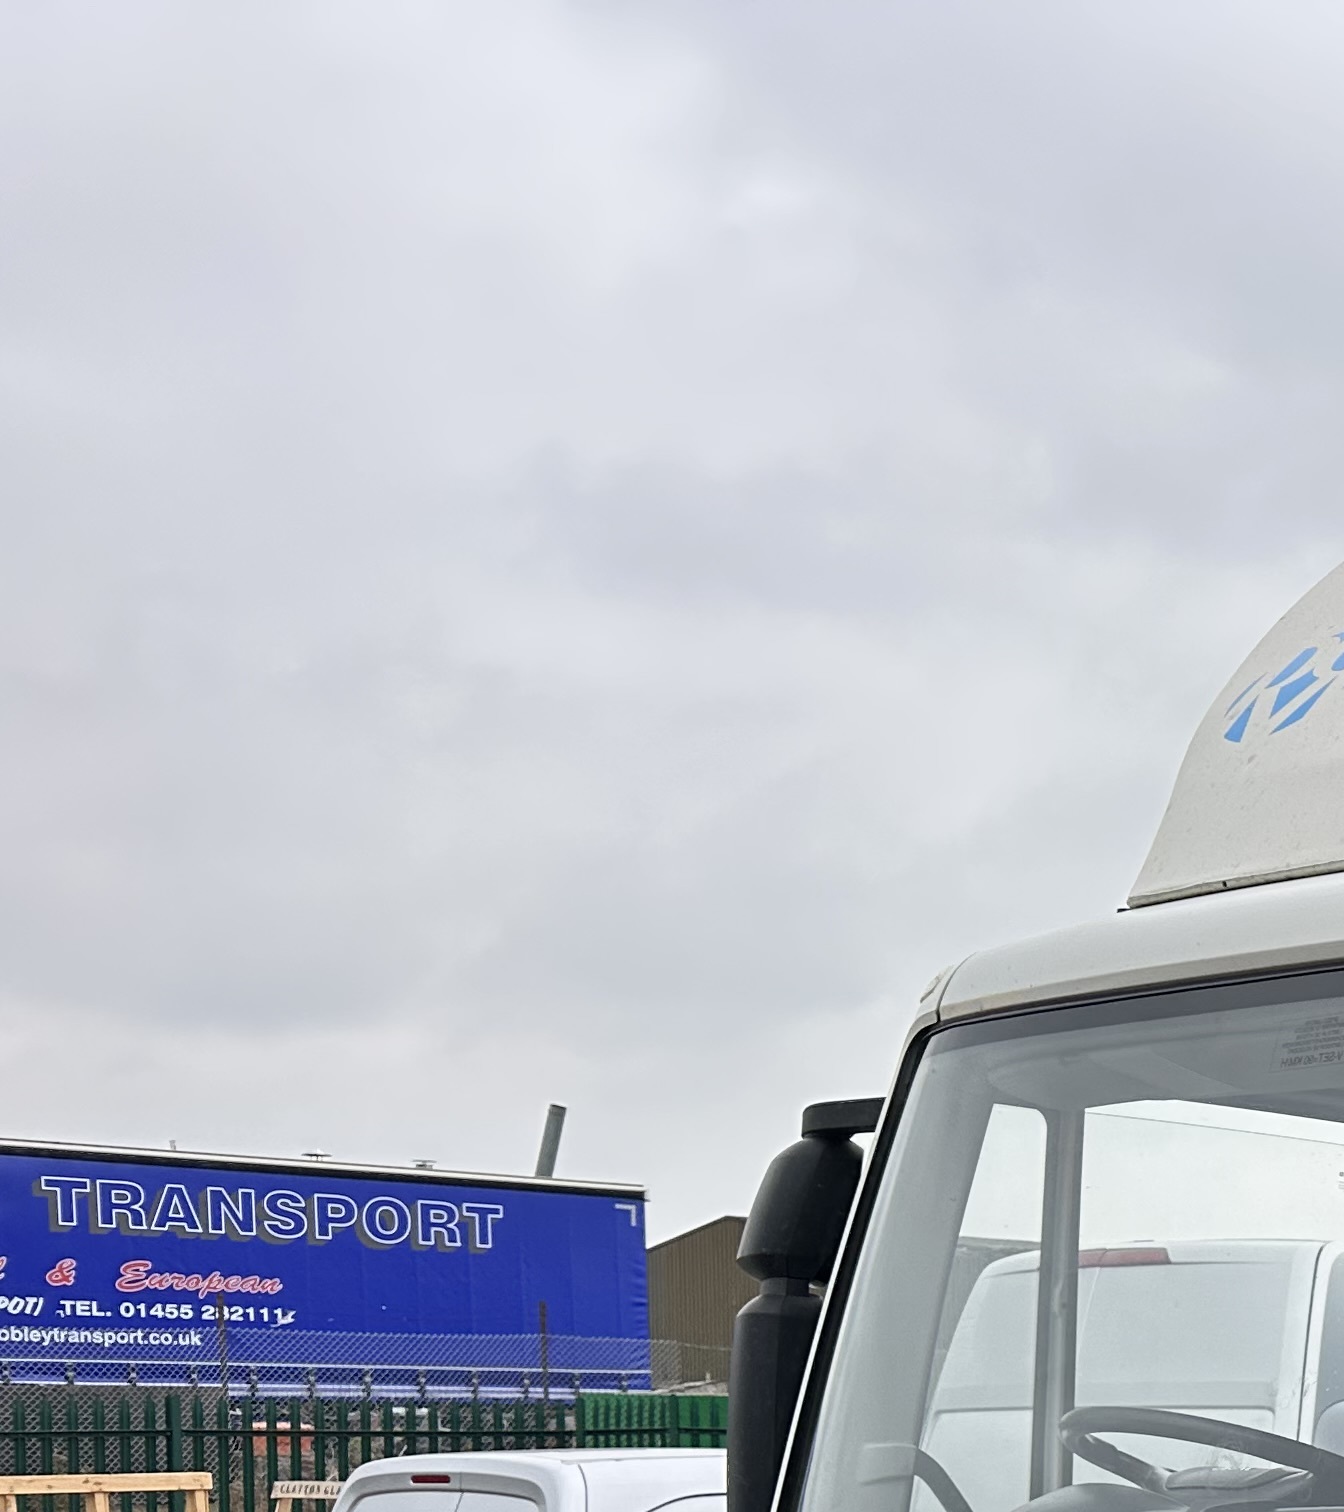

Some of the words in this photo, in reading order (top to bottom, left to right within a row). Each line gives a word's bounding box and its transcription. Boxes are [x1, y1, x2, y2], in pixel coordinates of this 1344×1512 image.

[36, 1175, 505, 1250] TRANSPORT
[46, 1258, 76, 1287] &
[115, 1259, 284, 1300] European
[60, 1300, 112, 1318] TEL.
[119, 1302, 194, 1319] 01455
